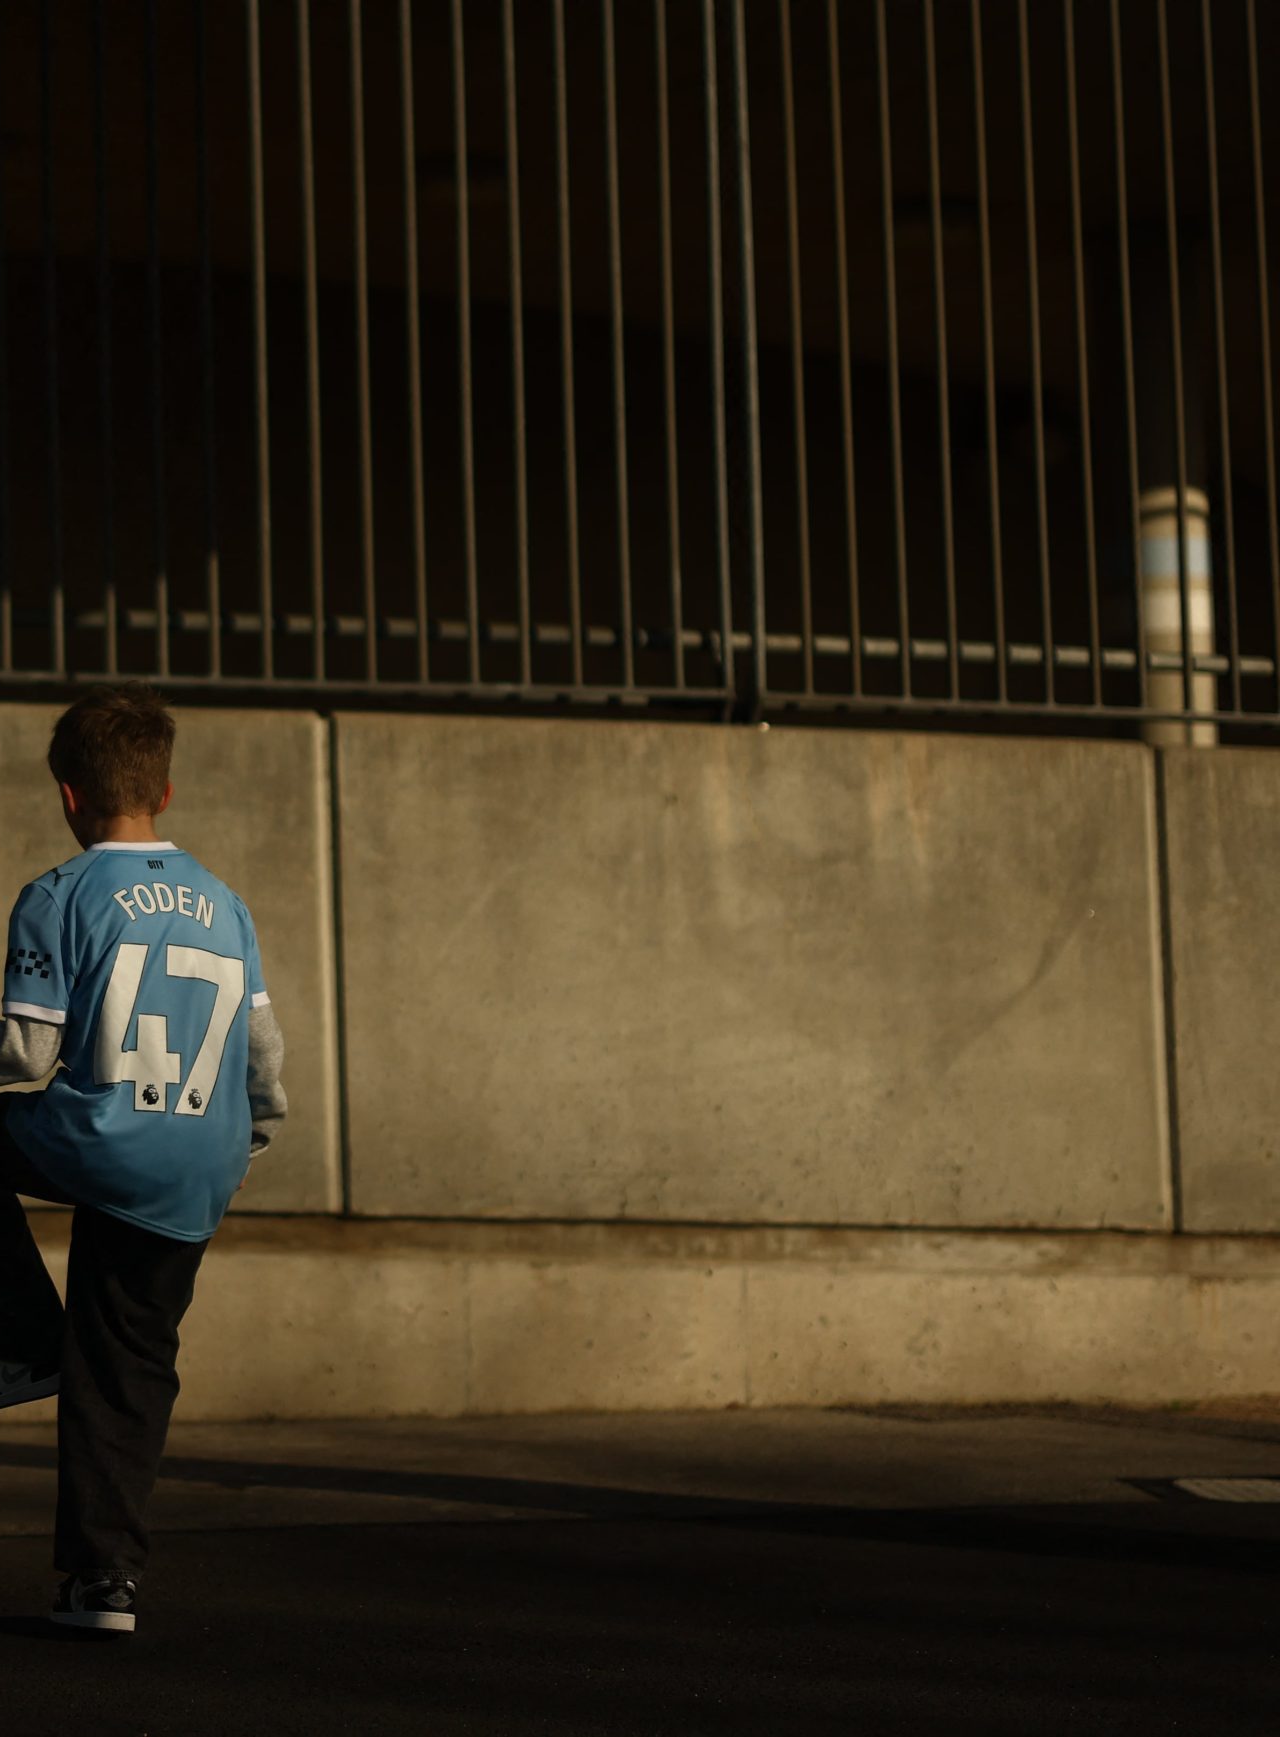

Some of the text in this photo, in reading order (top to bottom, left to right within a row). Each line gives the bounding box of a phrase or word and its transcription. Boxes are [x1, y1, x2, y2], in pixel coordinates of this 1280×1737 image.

[147, 860, 164, 870] CITY
[113, 882, 214, 929] FODEN
[93, 943, 245, 1117] 47
